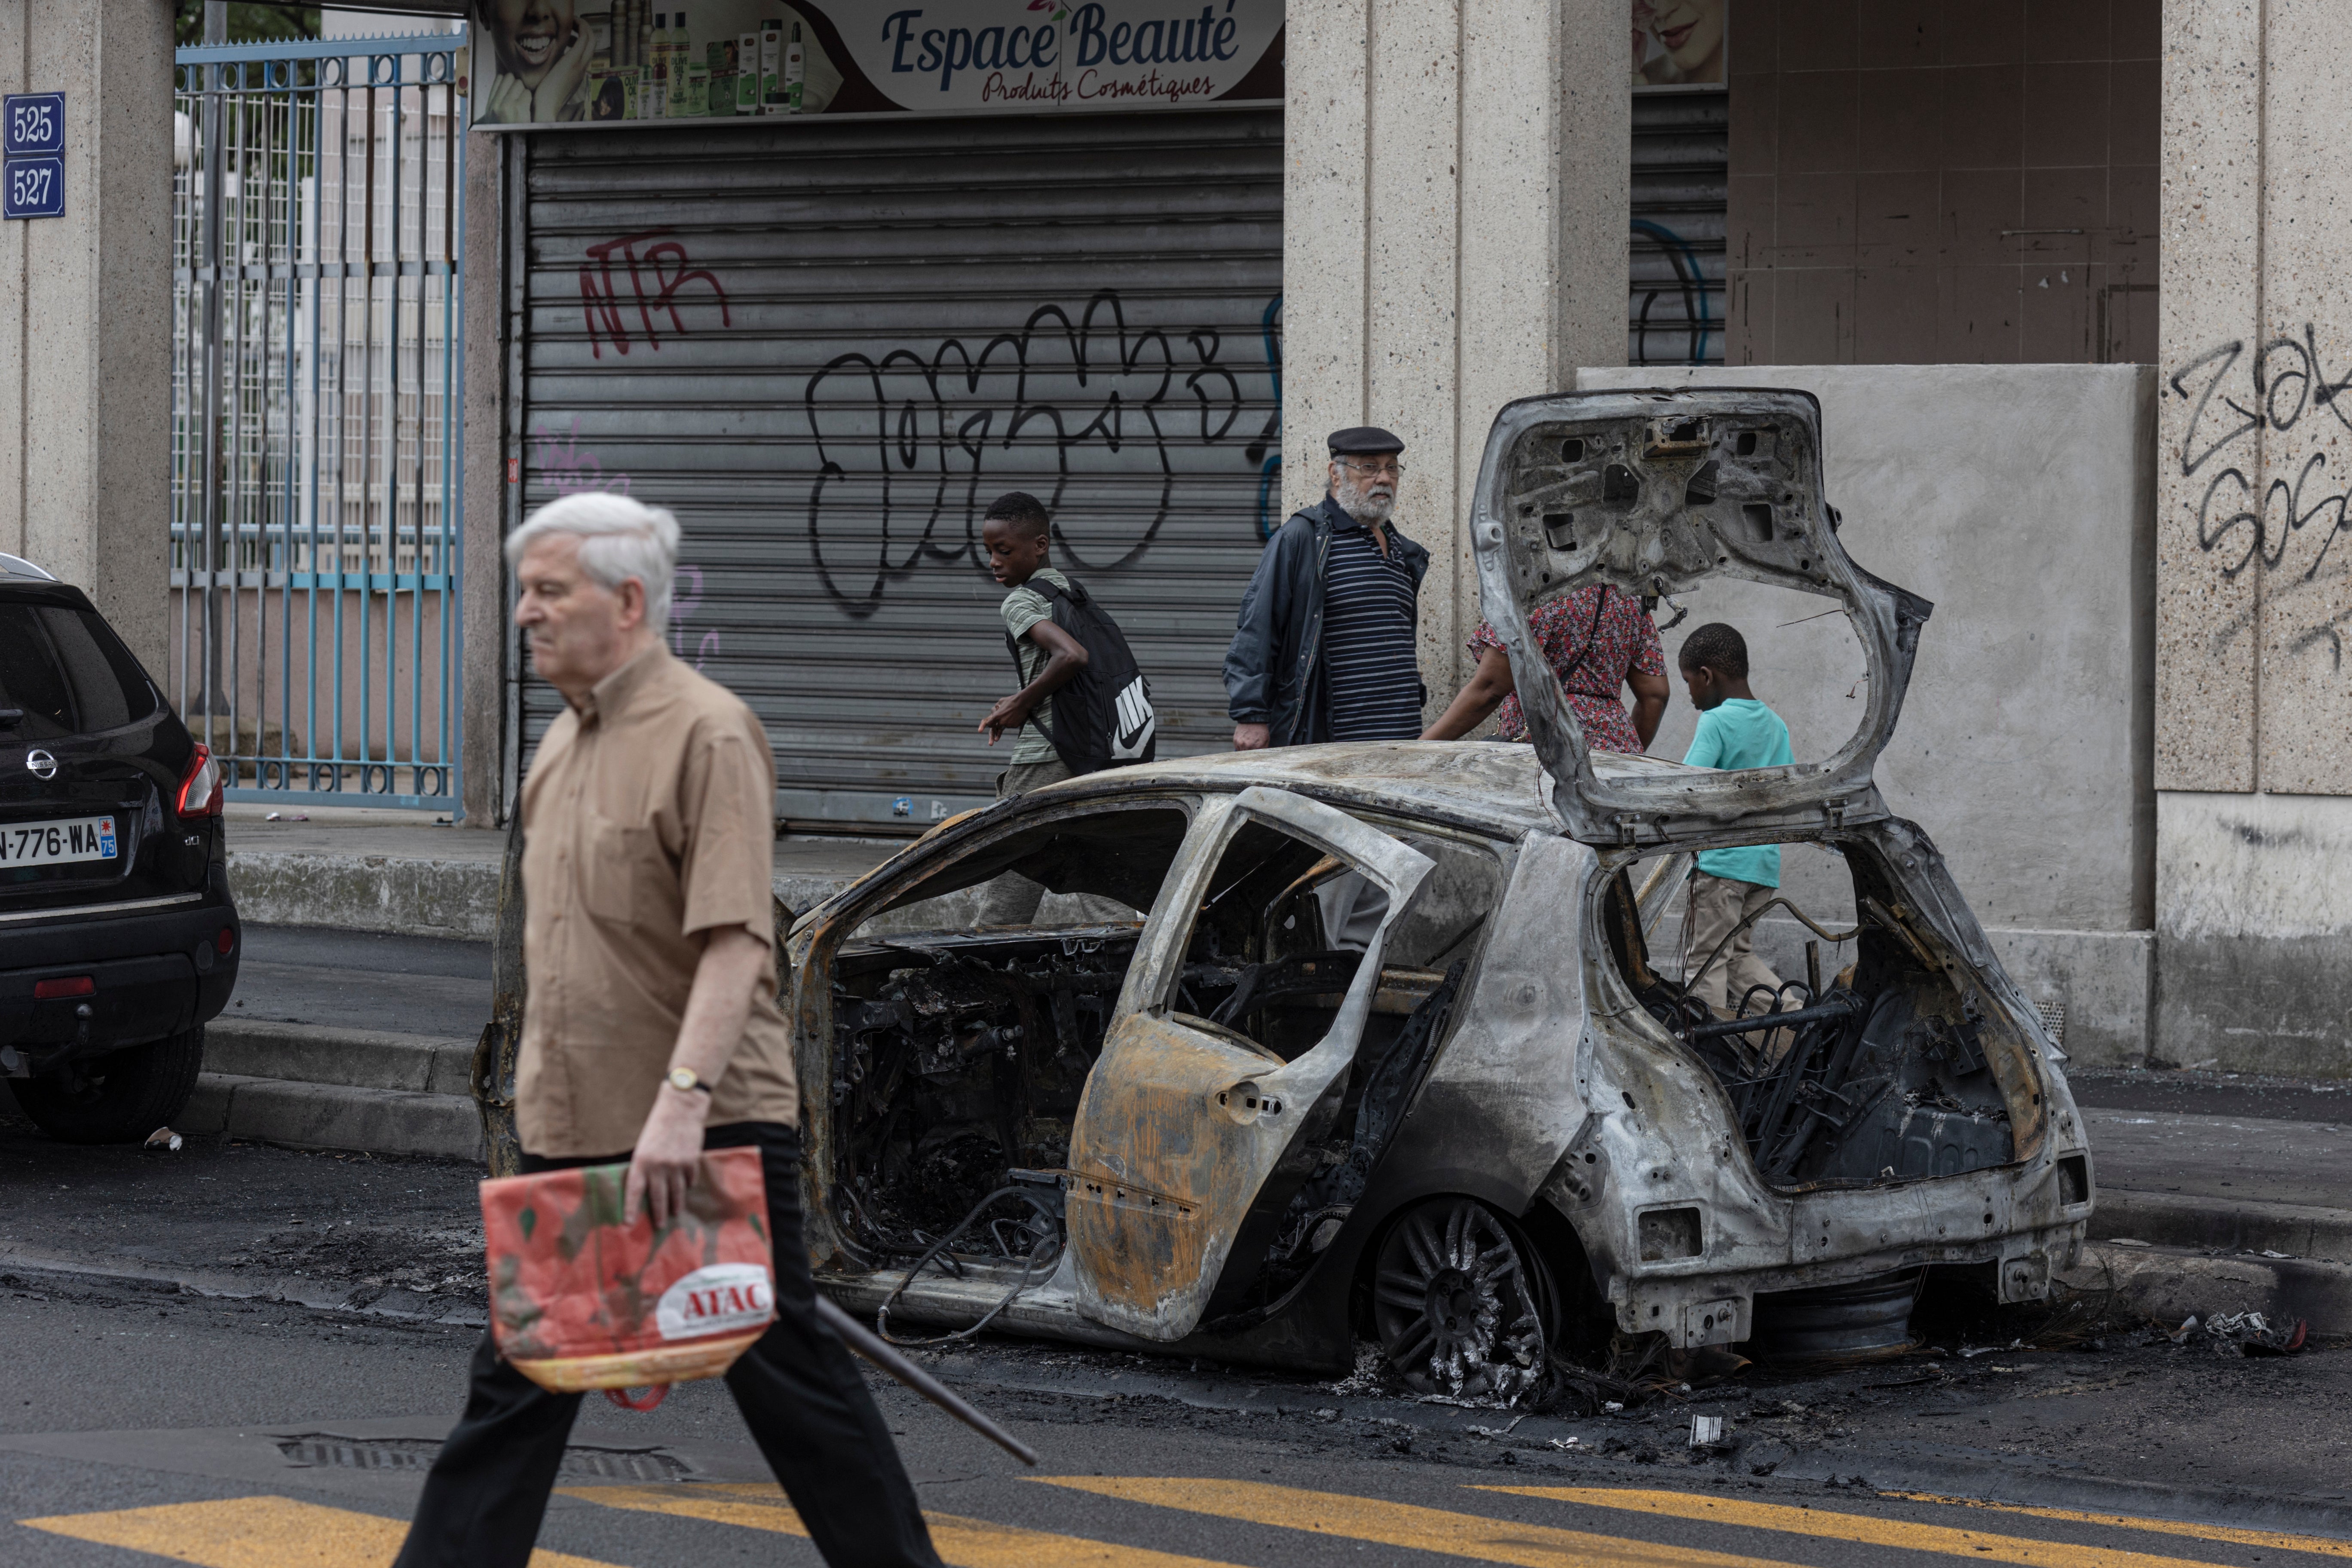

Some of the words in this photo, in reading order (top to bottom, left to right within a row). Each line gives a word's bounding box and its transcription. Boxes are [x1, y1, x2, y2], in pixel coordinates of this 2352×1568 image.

[882, 9, 1059, 92] Espace
[1069, 0, 1239, 67] Beauté
[982, 71, 1073, 102] Produits
[1077, 68, 1216, 103] Cosmétiques
[14, 106, 52, 142] 525
[14, 168, 52, 205] 527
[102, 839, 115, 854] 75
[683, 1283, 768, 1320] ATAC
